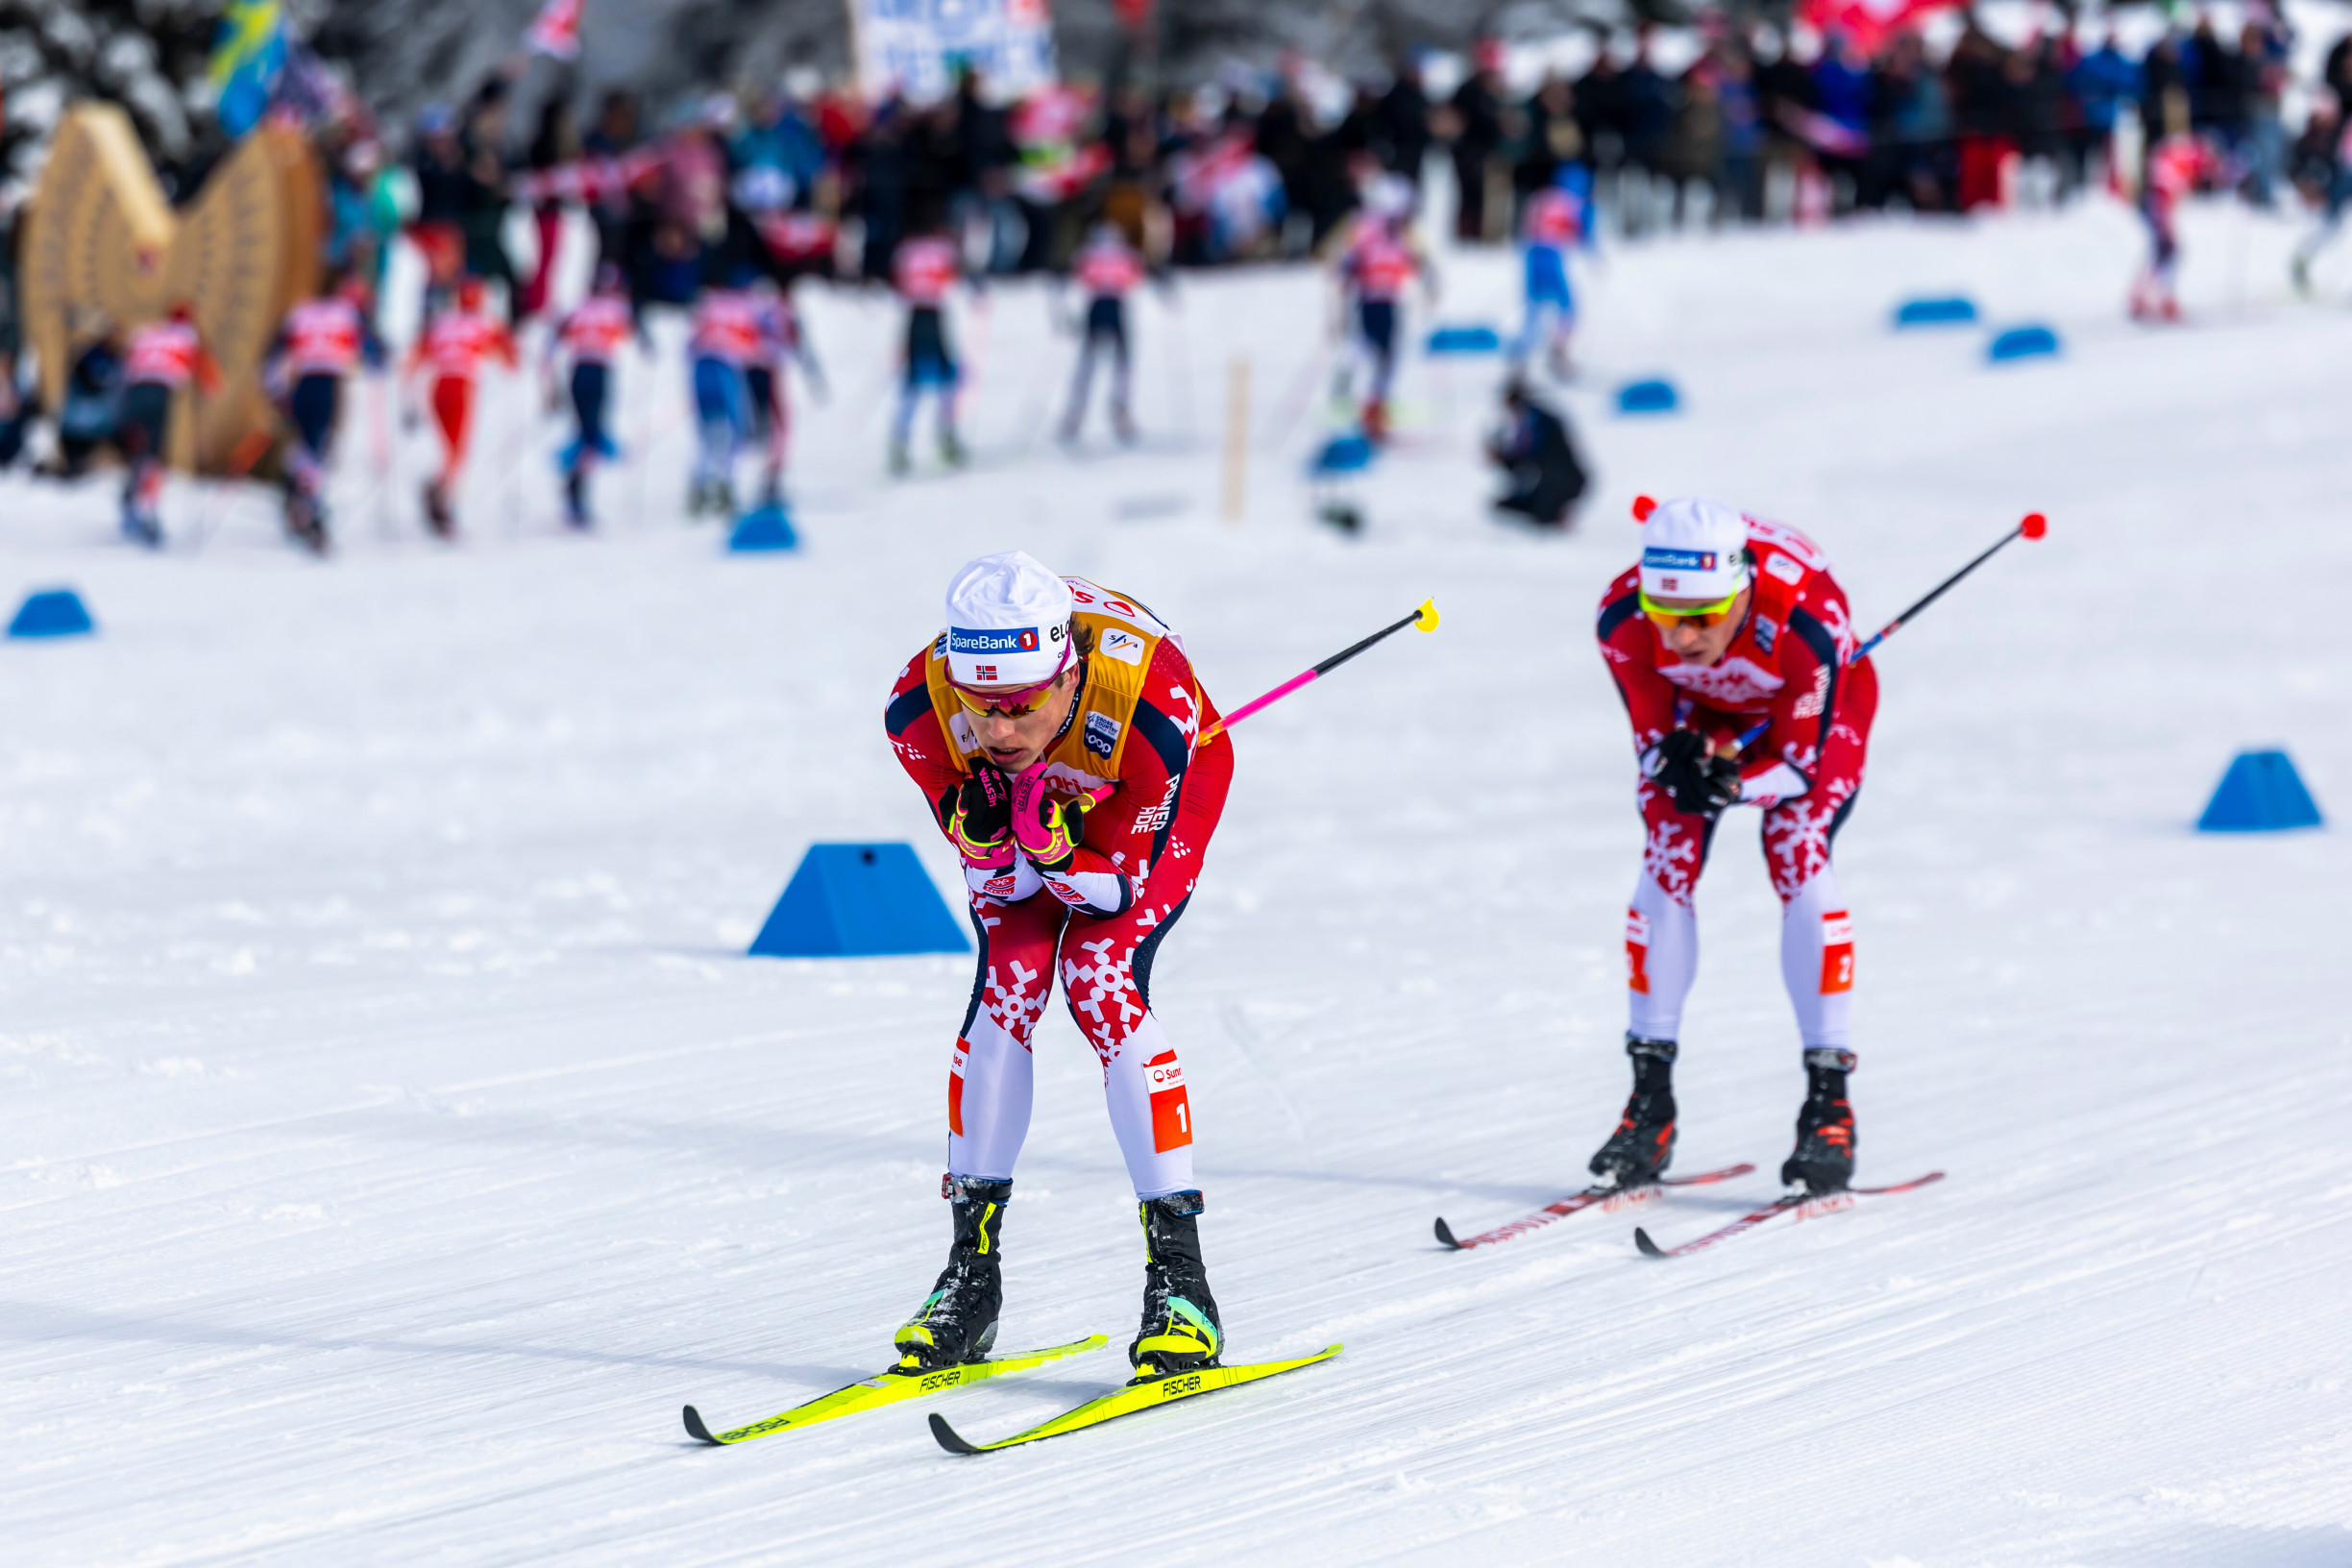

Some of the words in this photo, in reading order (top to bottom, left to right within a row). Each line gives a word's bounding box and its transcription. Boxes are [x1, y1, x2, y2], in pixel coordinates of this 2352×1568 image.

[951, 632, 1017, 649] SpareBank
[979, 768, 997, 807] HESTRA
[1017, 775, 1035, 813] HESTRA
[1148, 772, 1181, 833] POWER
[1130, 806, 1158, 835] ADE
[1176, 1103, 1188, 1134] 1
[919, 1371, 961, 1392] FISCHER
[1163, 1376, 1201, 1397] FISCHER
